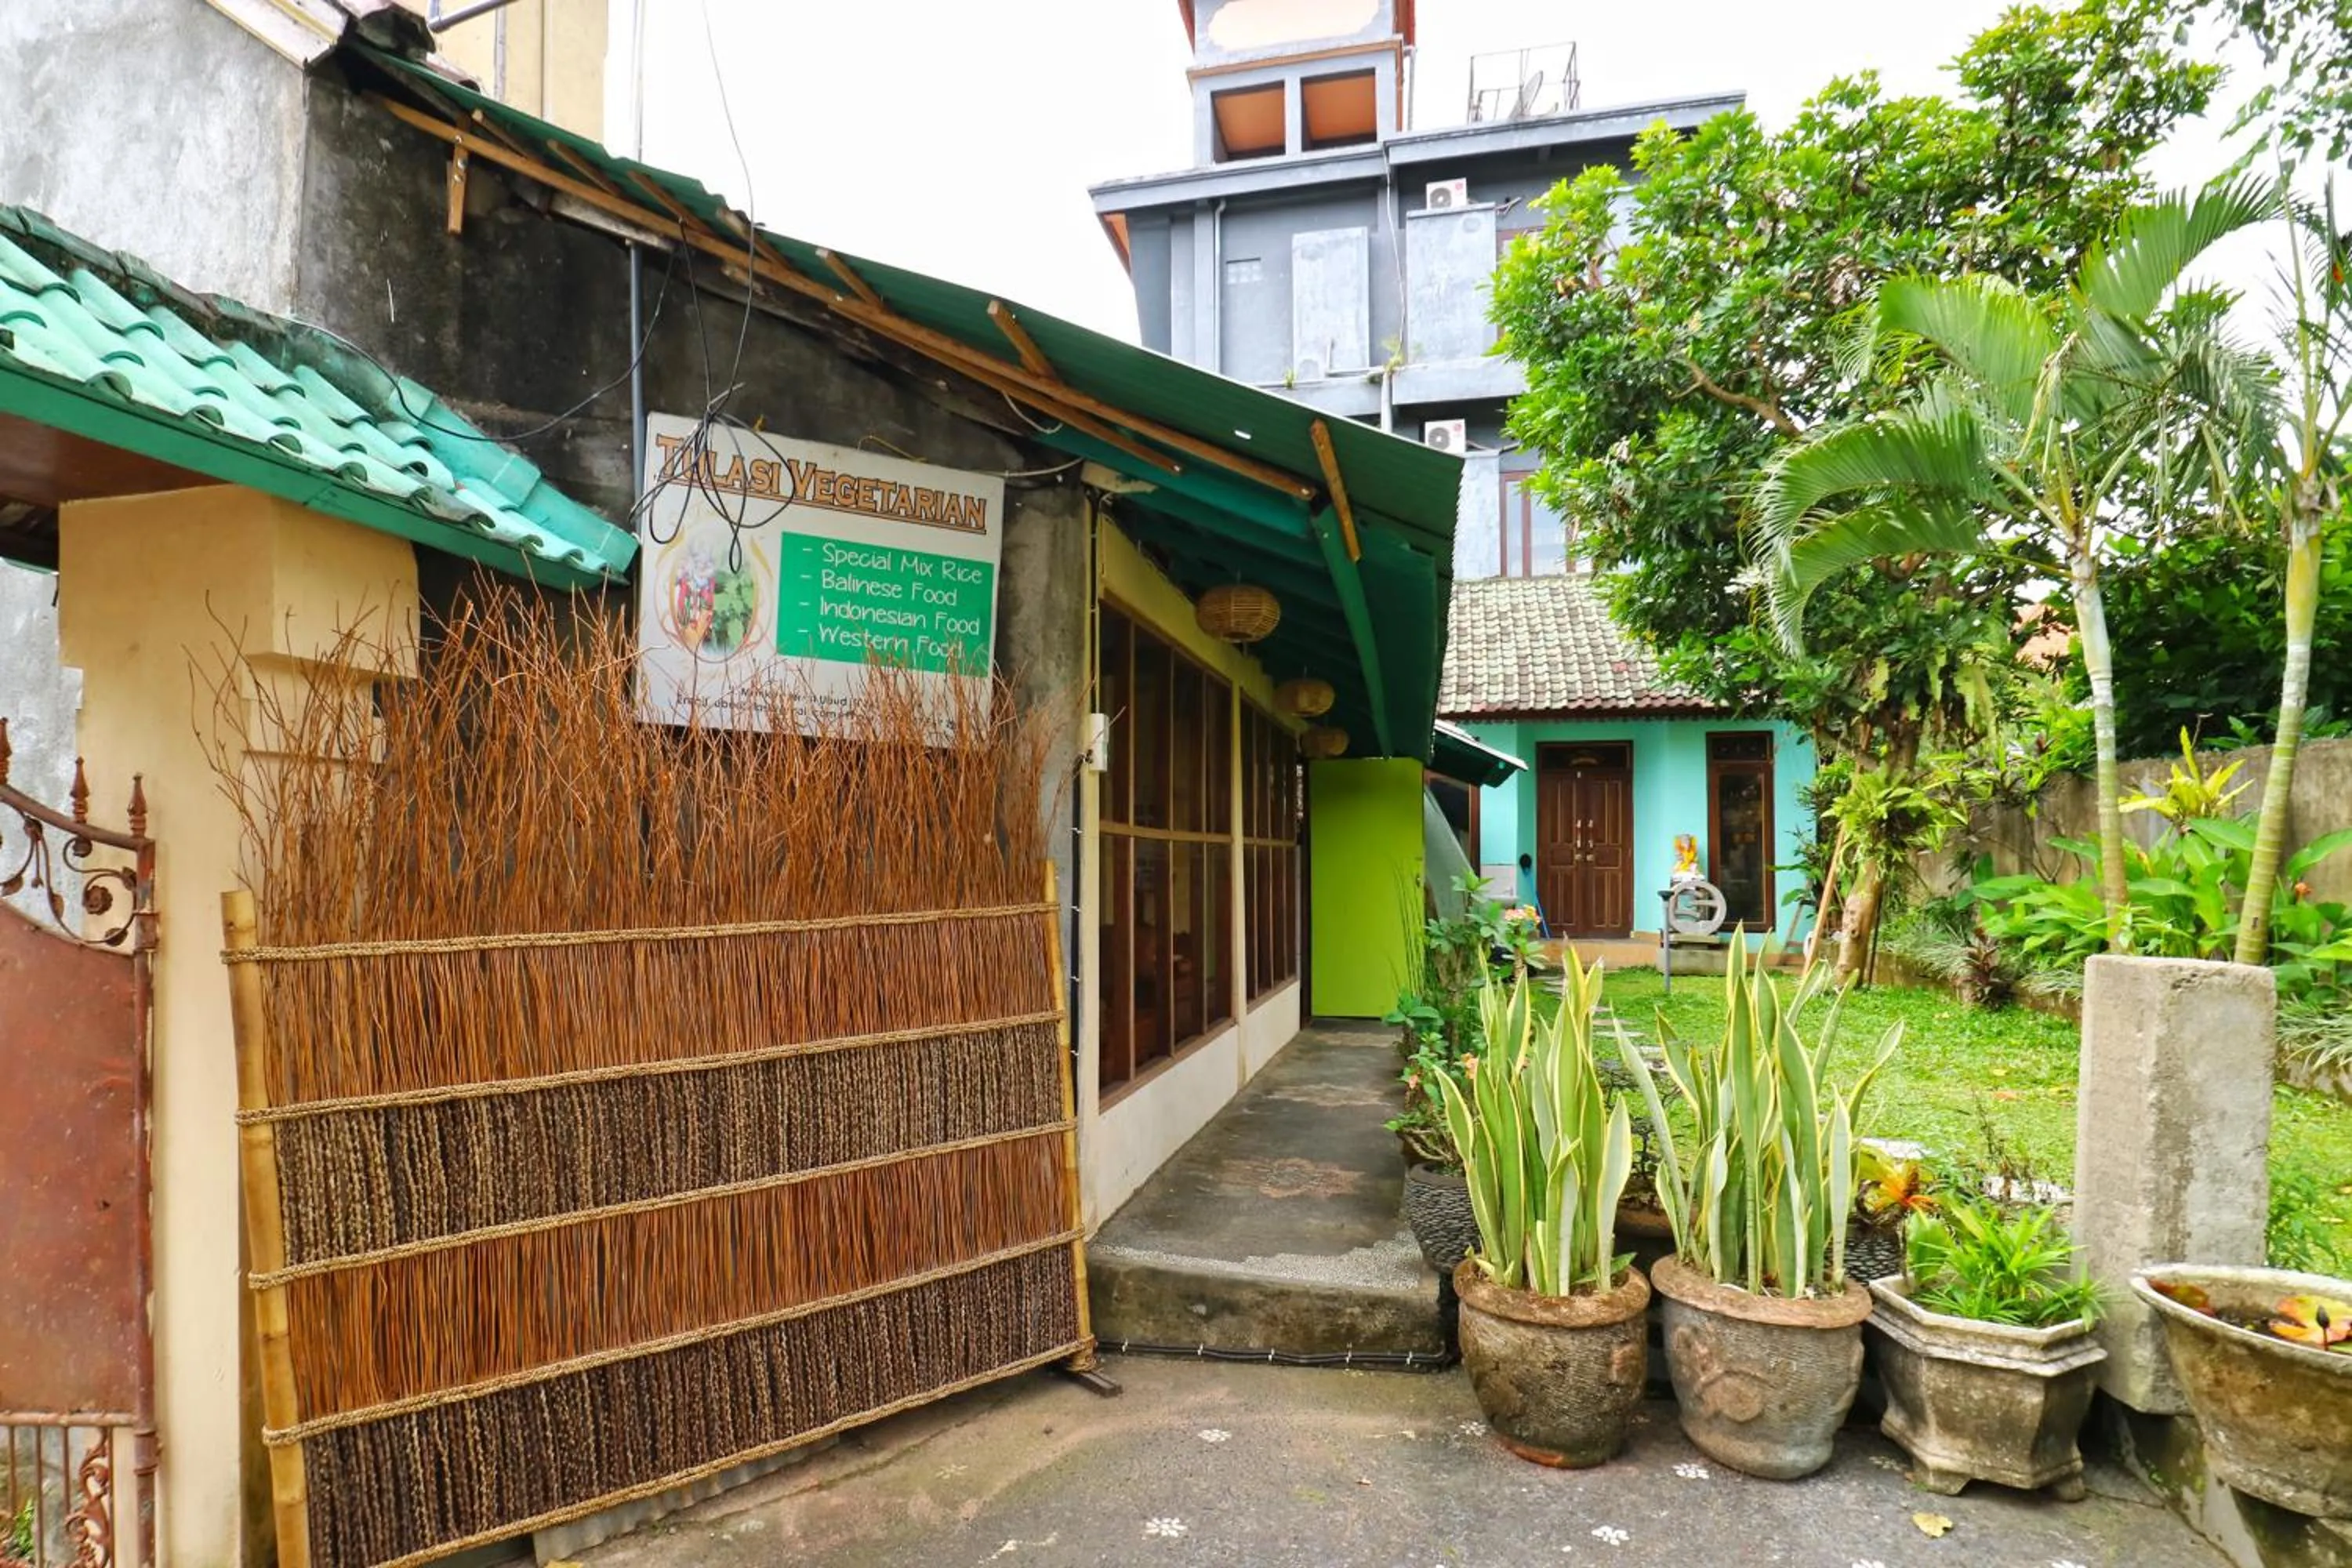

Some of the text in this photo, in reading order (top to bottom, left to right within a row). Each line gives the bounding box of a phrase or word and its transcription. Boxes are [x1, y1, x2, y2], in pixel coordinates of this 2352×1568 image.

[655, 433, 987, 530] TULASI VEGETARIAN
[823, 542, 891, 572] Special
[901, 555, 933, 578] Mix
[941, 561, 982, 584] Rice
[821, 569, 902, 599] Balinese
[911, 582, 957, 607] Food
[820, 595, 926, 629] Indonesian
[935, 612, 979, 636] Food
[818, 622, 908, 653] Western
